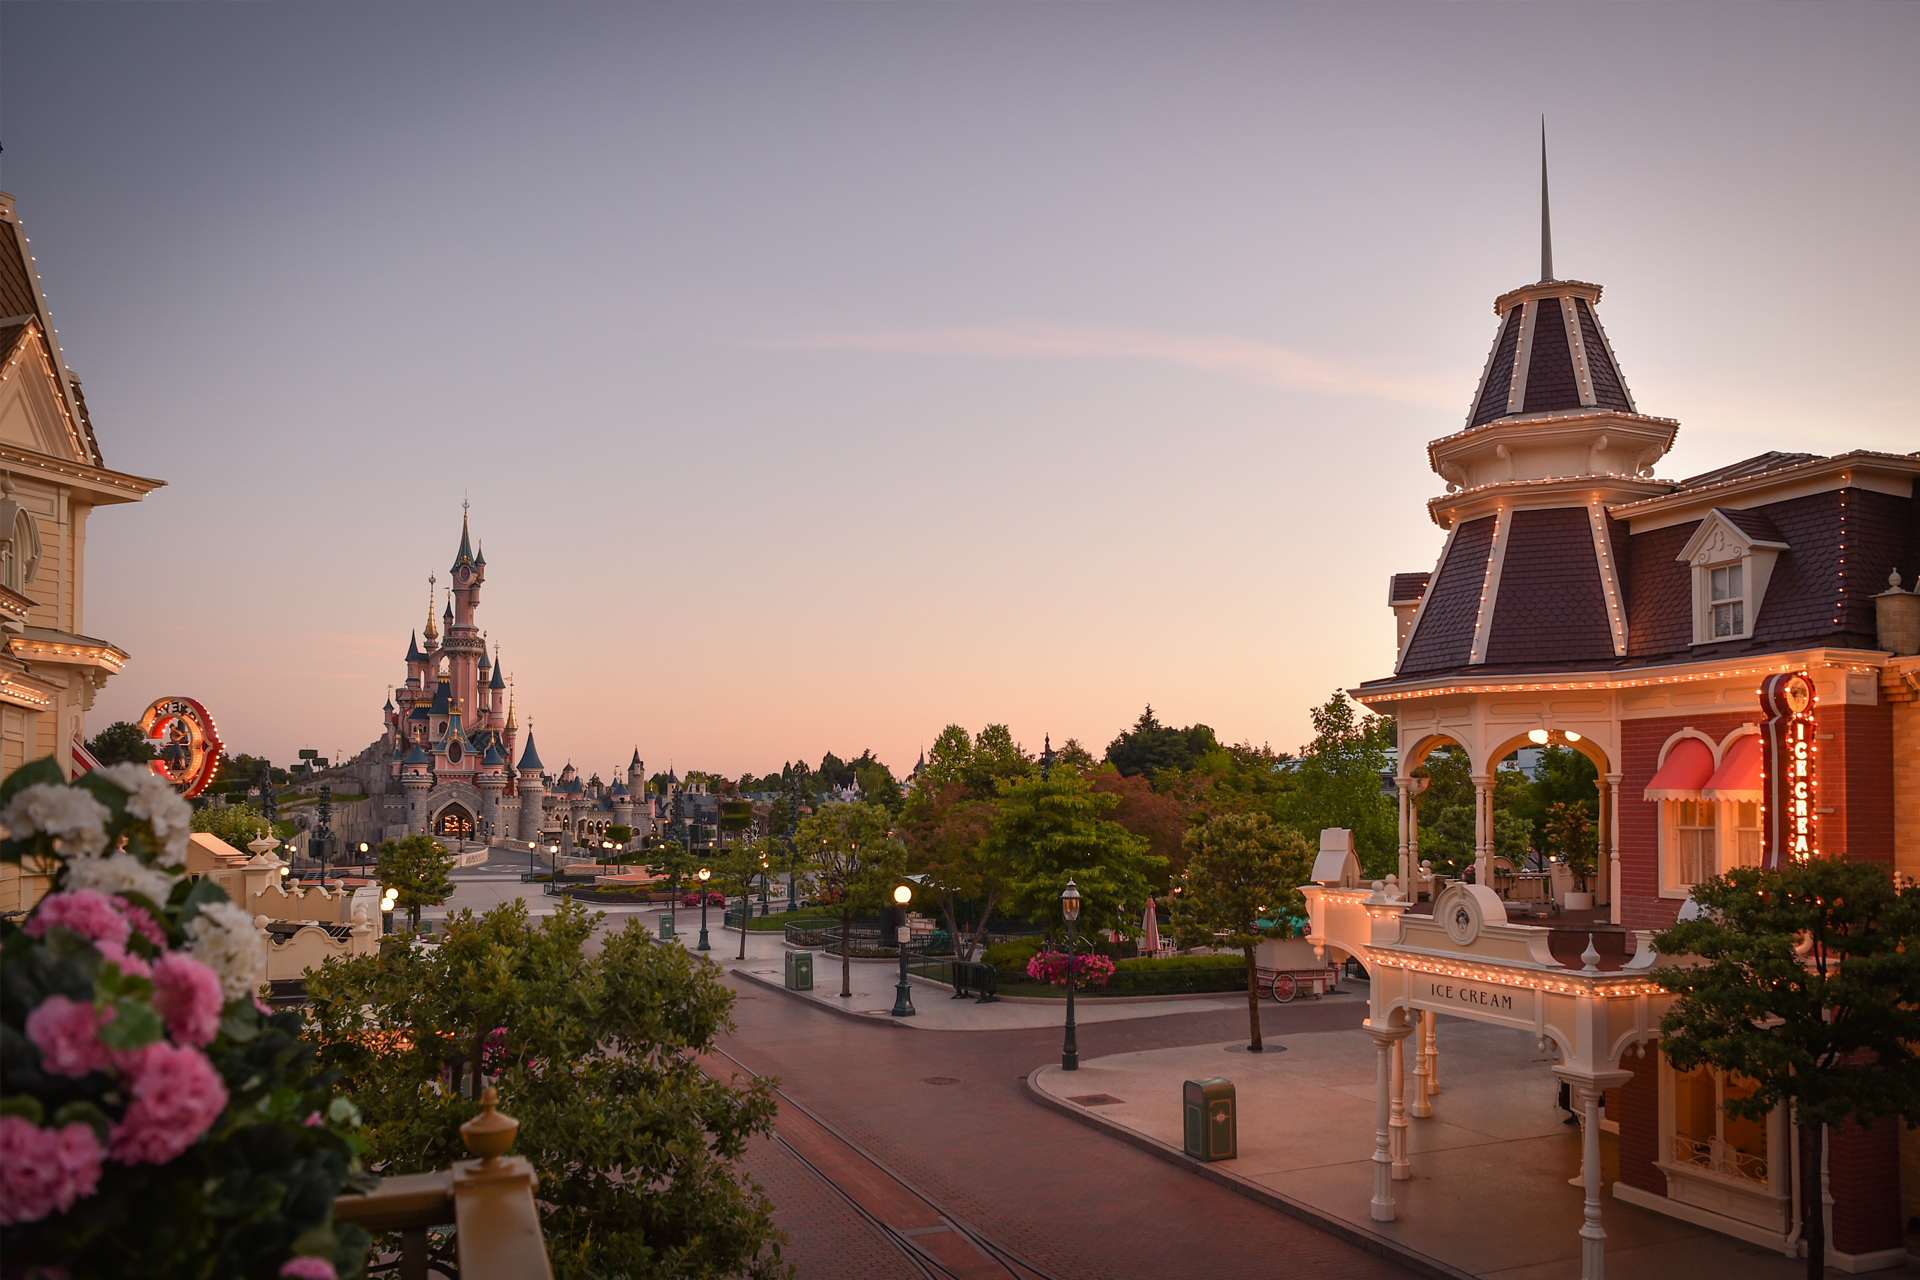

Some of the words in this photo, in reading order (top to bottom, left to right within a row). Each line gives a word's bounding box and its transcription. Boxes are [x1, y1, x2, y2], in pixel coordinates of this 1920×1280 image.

[1795, 723, 1807, 776] ICE
[1431, 983, 1453, 999] ICE
[1459, 988, 1512, 1010] CREAM
